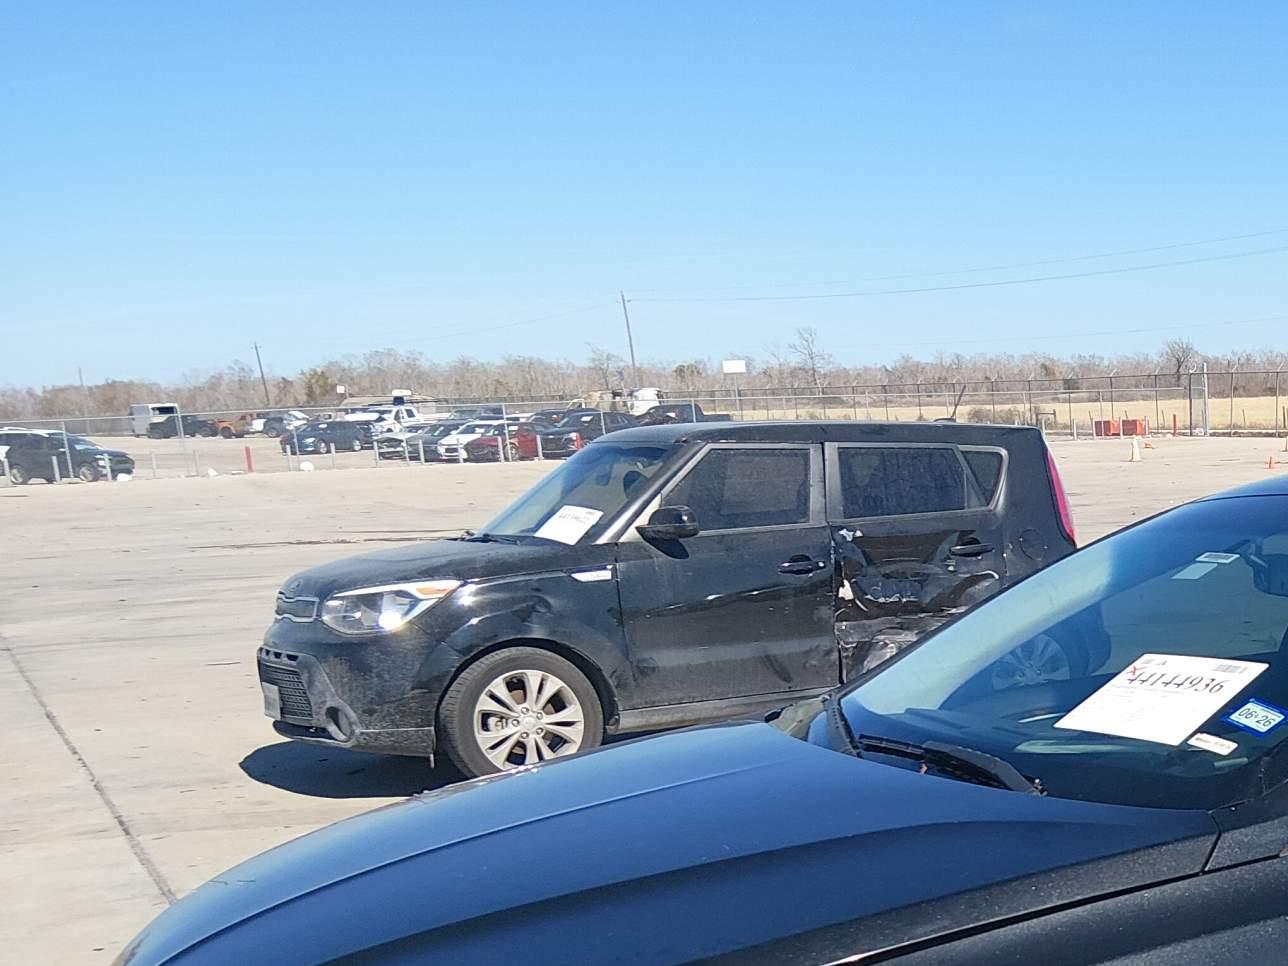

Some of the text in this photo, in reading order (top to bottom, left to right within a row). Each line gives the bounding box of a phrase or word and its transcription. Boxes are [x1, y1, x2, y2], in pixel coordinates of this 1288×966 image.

[1127, 671, 1227, 694] 44144936
[1238, 707, 1276, 728] 06 26
